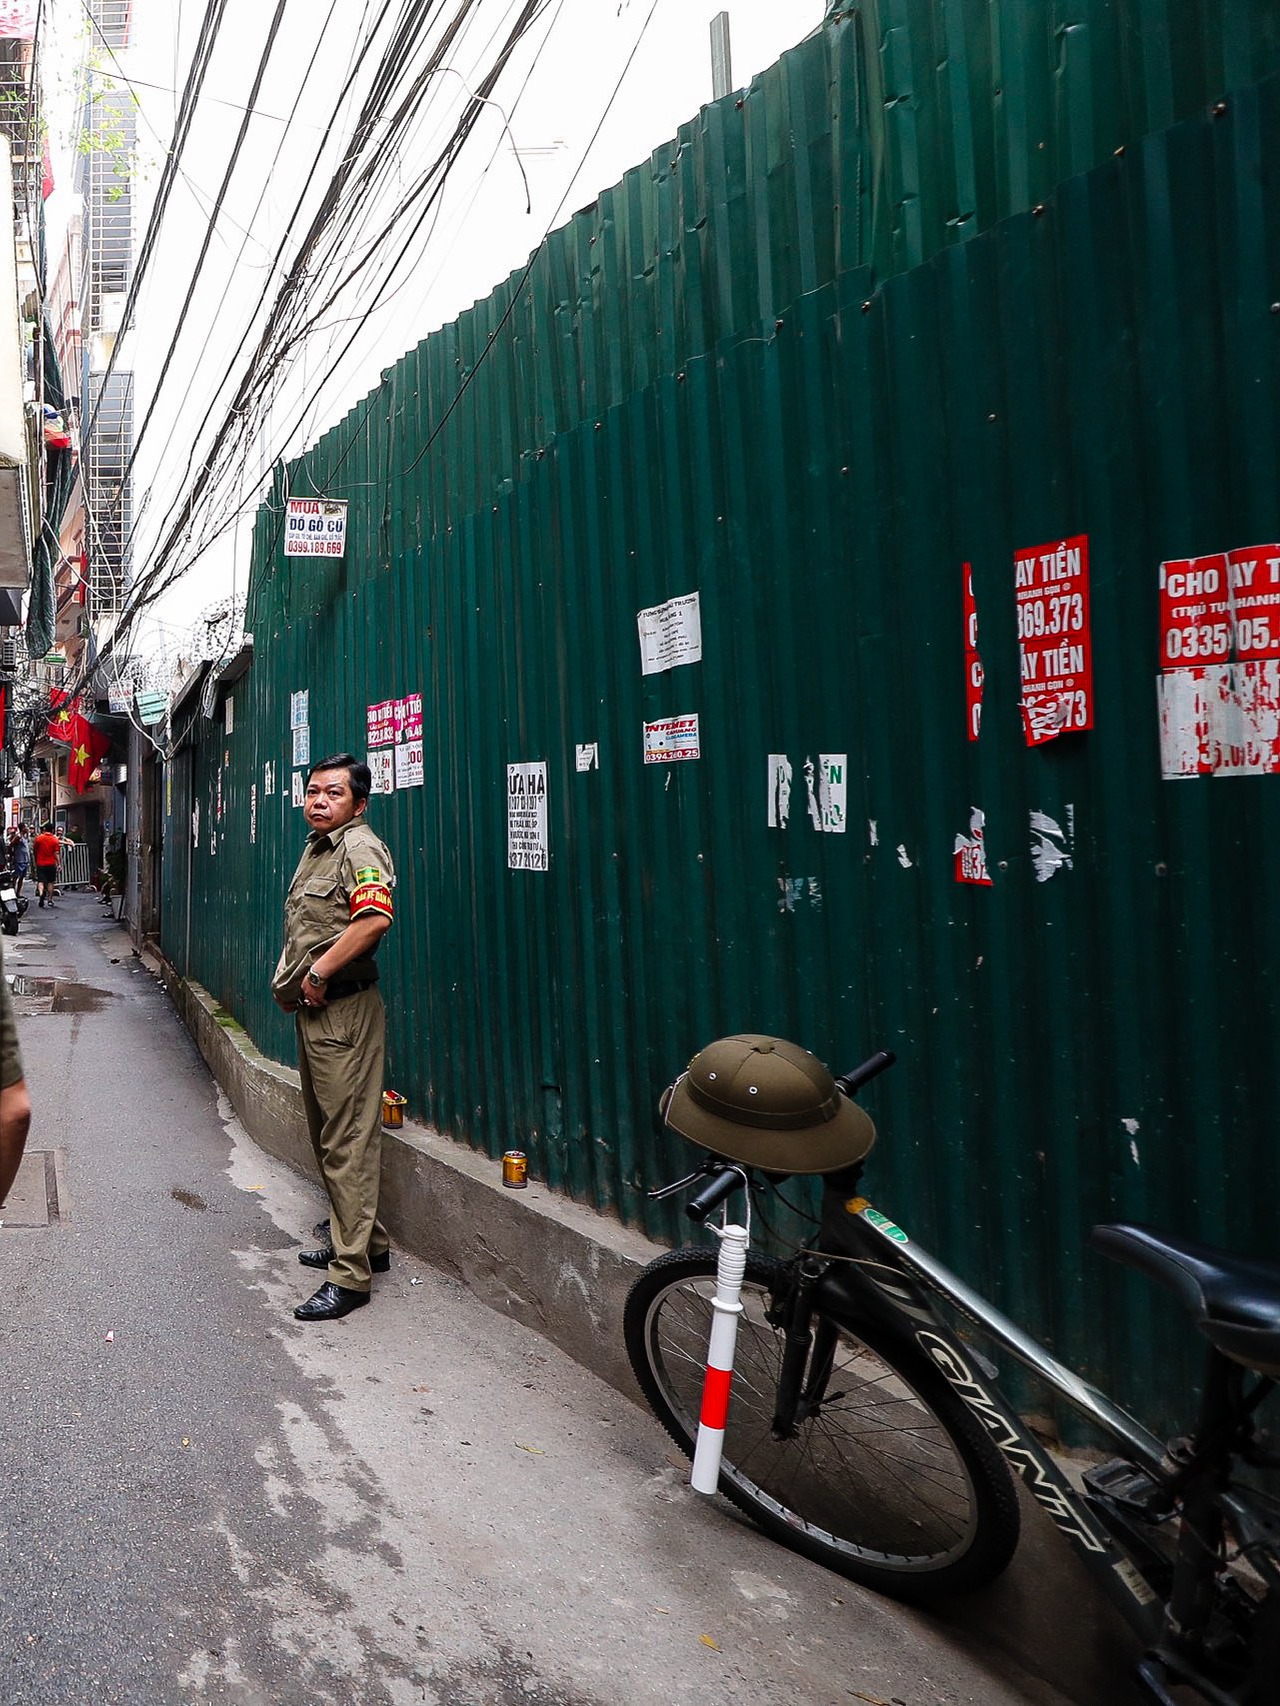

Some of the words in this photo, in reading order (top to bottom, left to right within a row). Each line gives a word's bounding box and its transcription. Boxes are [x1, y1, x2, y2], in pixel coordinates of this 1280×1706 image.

[290, 501, 320, 514] MUA
[288, 540, 342, 555] 0399.189.669
[1015, 557, 1036, 588] AY
[1039, 541, 1081, 583] TIỀN
[1167, 568, 1219, 598] CHO
[1230, 560, 1258, 589] AY
[1020, 652, 1039, 681] AY
[1042, 638, 1085, 678] TIỀN
